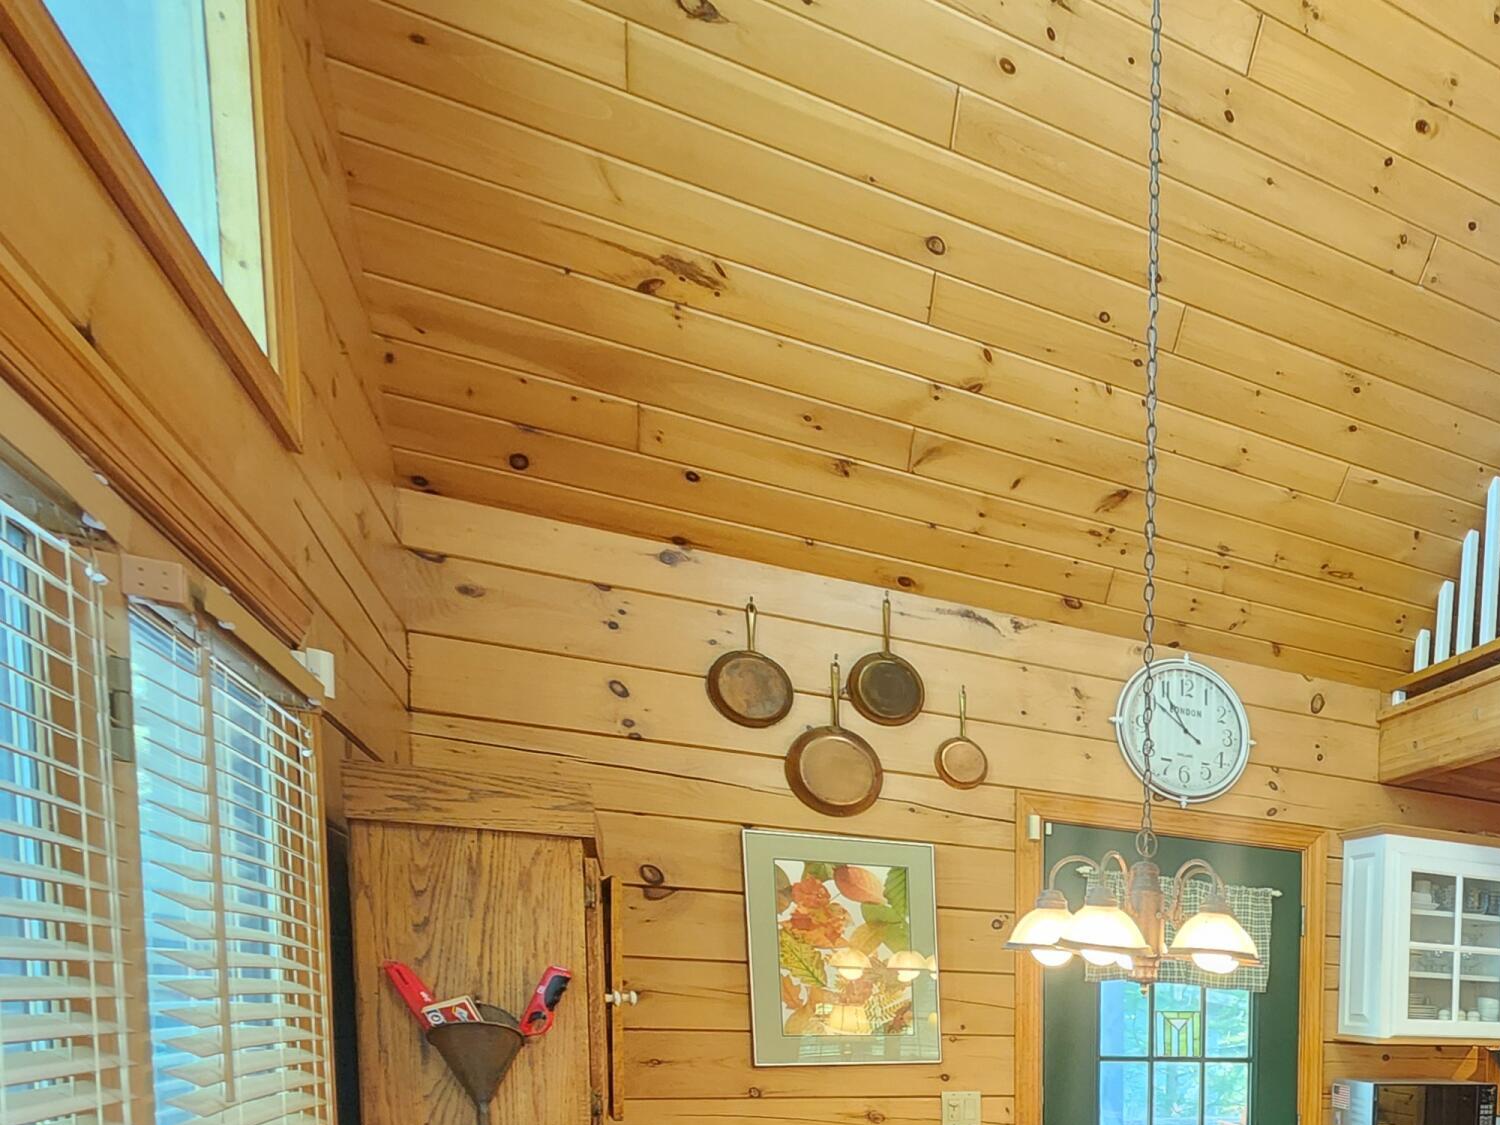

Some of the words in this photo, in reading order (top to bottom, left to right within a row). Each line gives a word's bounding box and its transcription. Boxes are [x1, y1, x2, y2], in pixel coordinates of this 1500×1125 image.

[1180, 679, 1195, 698] 12
[1204, 687, 1209, 706] 1
[1169, 703, 1203, 719] LONDON
[1216, 705, 1227, 725] 2
[1222, 728, 1234, 748] 3
[1160, 757, 1173, 776] 7
[1213, 751, 1225, 769] 4
[1178, 764, 1191, 785] 6
[1199, 762, 1213, 781] 5
